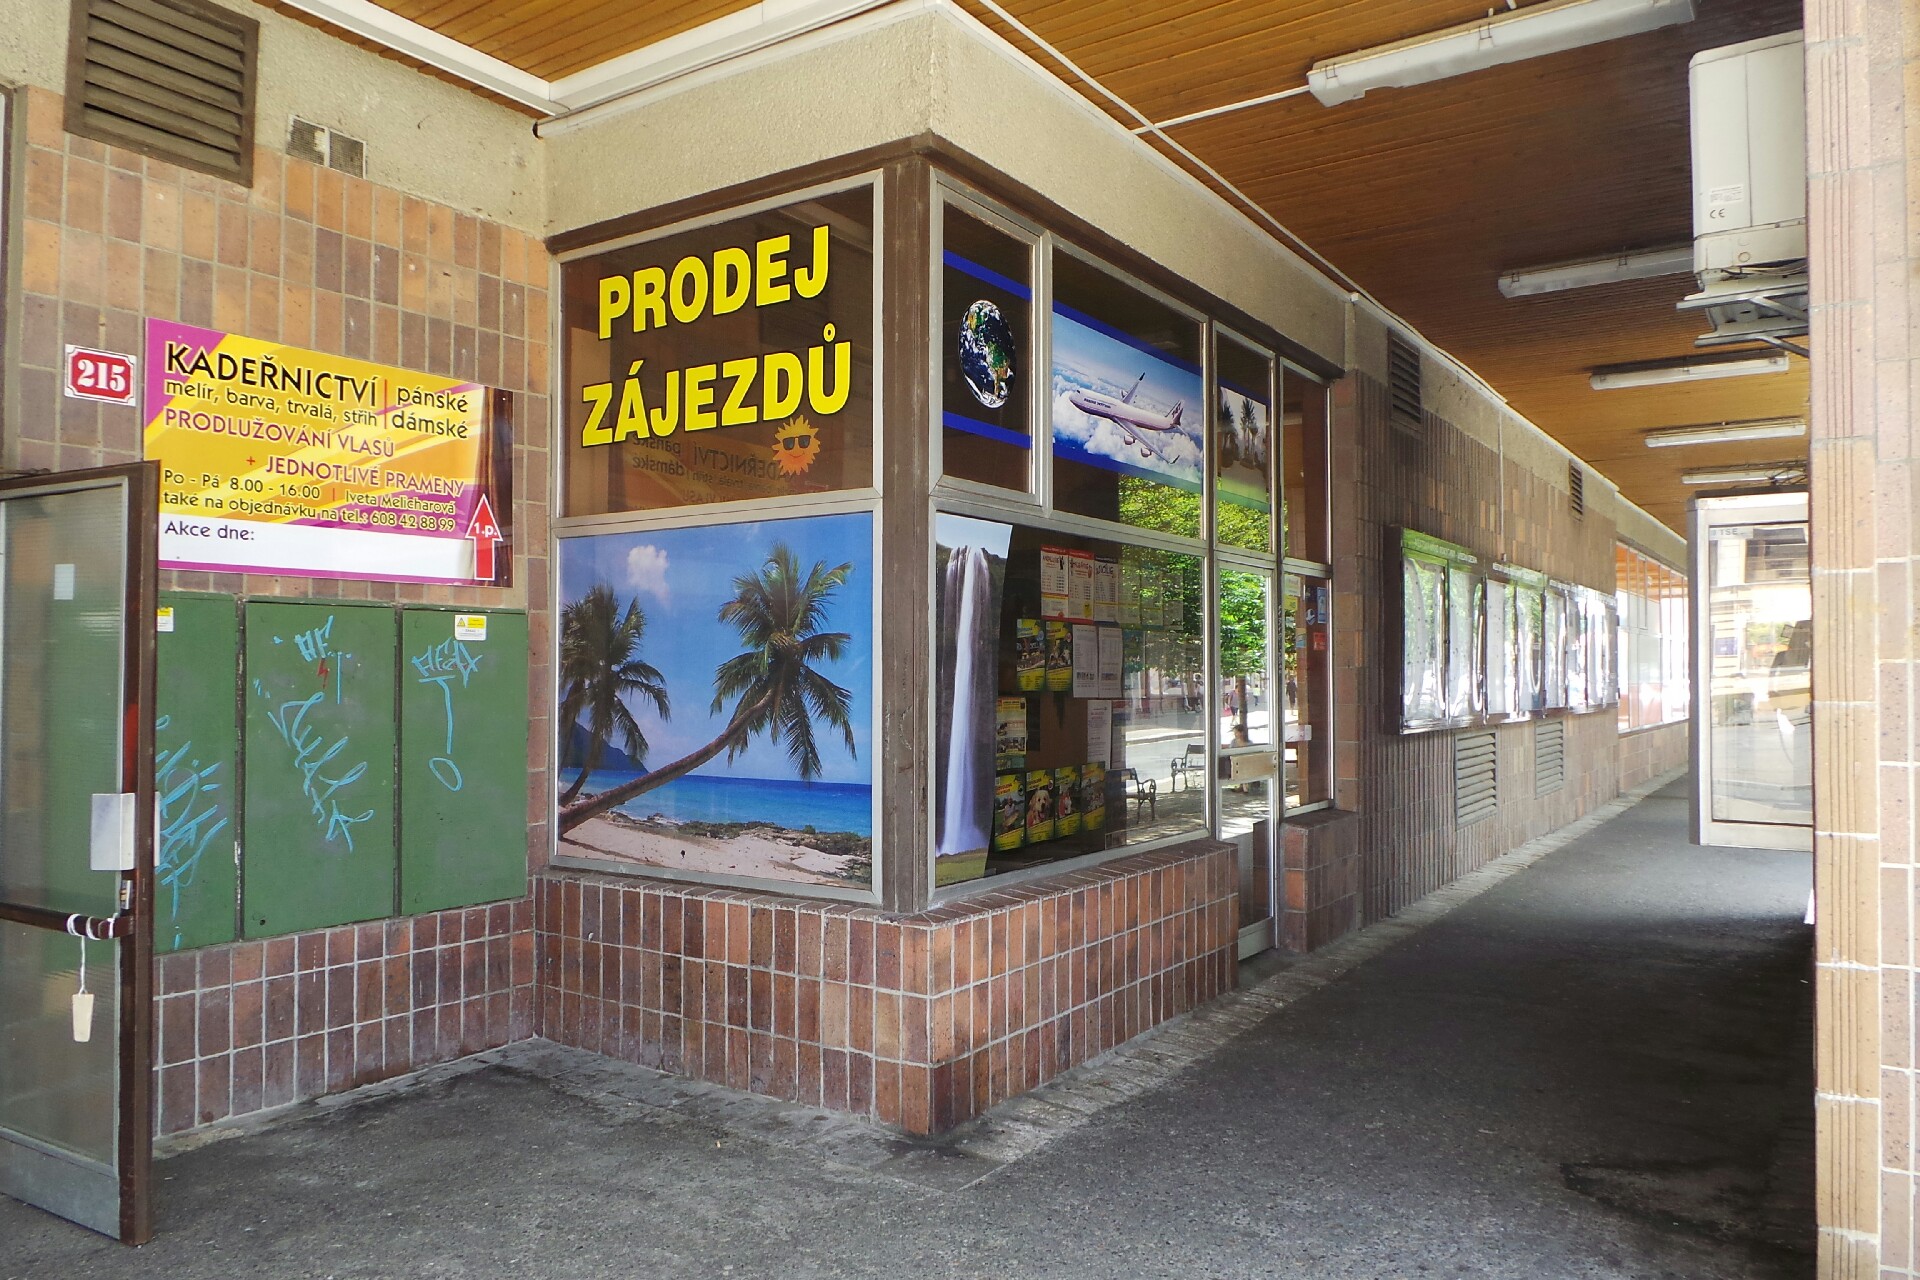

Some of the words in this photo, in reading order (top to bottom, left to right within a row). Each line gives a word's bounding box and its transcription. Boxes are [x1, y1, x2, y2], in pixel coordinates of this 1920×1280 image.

[598, 224, 829, 340] PRODEJ
[77, 359, 126, 392] 215
[167, 343, 379, 407] KADEŘNICTVÍ
[582, 322, 851, 448] ZÁJEZDŮ
[165, 380, 219, 403] melír,
[226, 387, 280, 413] barva,
[287, 399, 337, 423] trvalá,
[343, 408, 377, 427] střih
[397, 386, 468, 413] pánské
[165, 408, 332, 449] PRODLUŽOVÁNÍ
[337, 434, 394, 458] VLASŮ
[391, 410, 468, 439] dámské
[164, 469, 185, 484] Po
[202, 474, 220, 489] Pá
[229, 477, 264, 493] 8.00
[280, 484, 321, 499] 16.00
[265, 456, 379, 487] JEDNOTLIVÉ
[386, 471, 465, 498] PRAMENY
[163, 491, 199, 506] také
[204, 497, 223, 509] na
[229, 499, 316, 518] objednávku
[321, 507, 338, 520] na
[372, 512, 396, 525] 608
[399, 515, 416, 528] 42
[420, 516, 436, 530] 88
[439, 518, 456, 532] 99
[346, 490, 377, 506] Iveta
[381, 495, 456, 515] Melicharová
[164, 520, 211, 538] Akce
[217, 524, 255, 541] dne:
[473, 522, 498, 537] 1.p.
